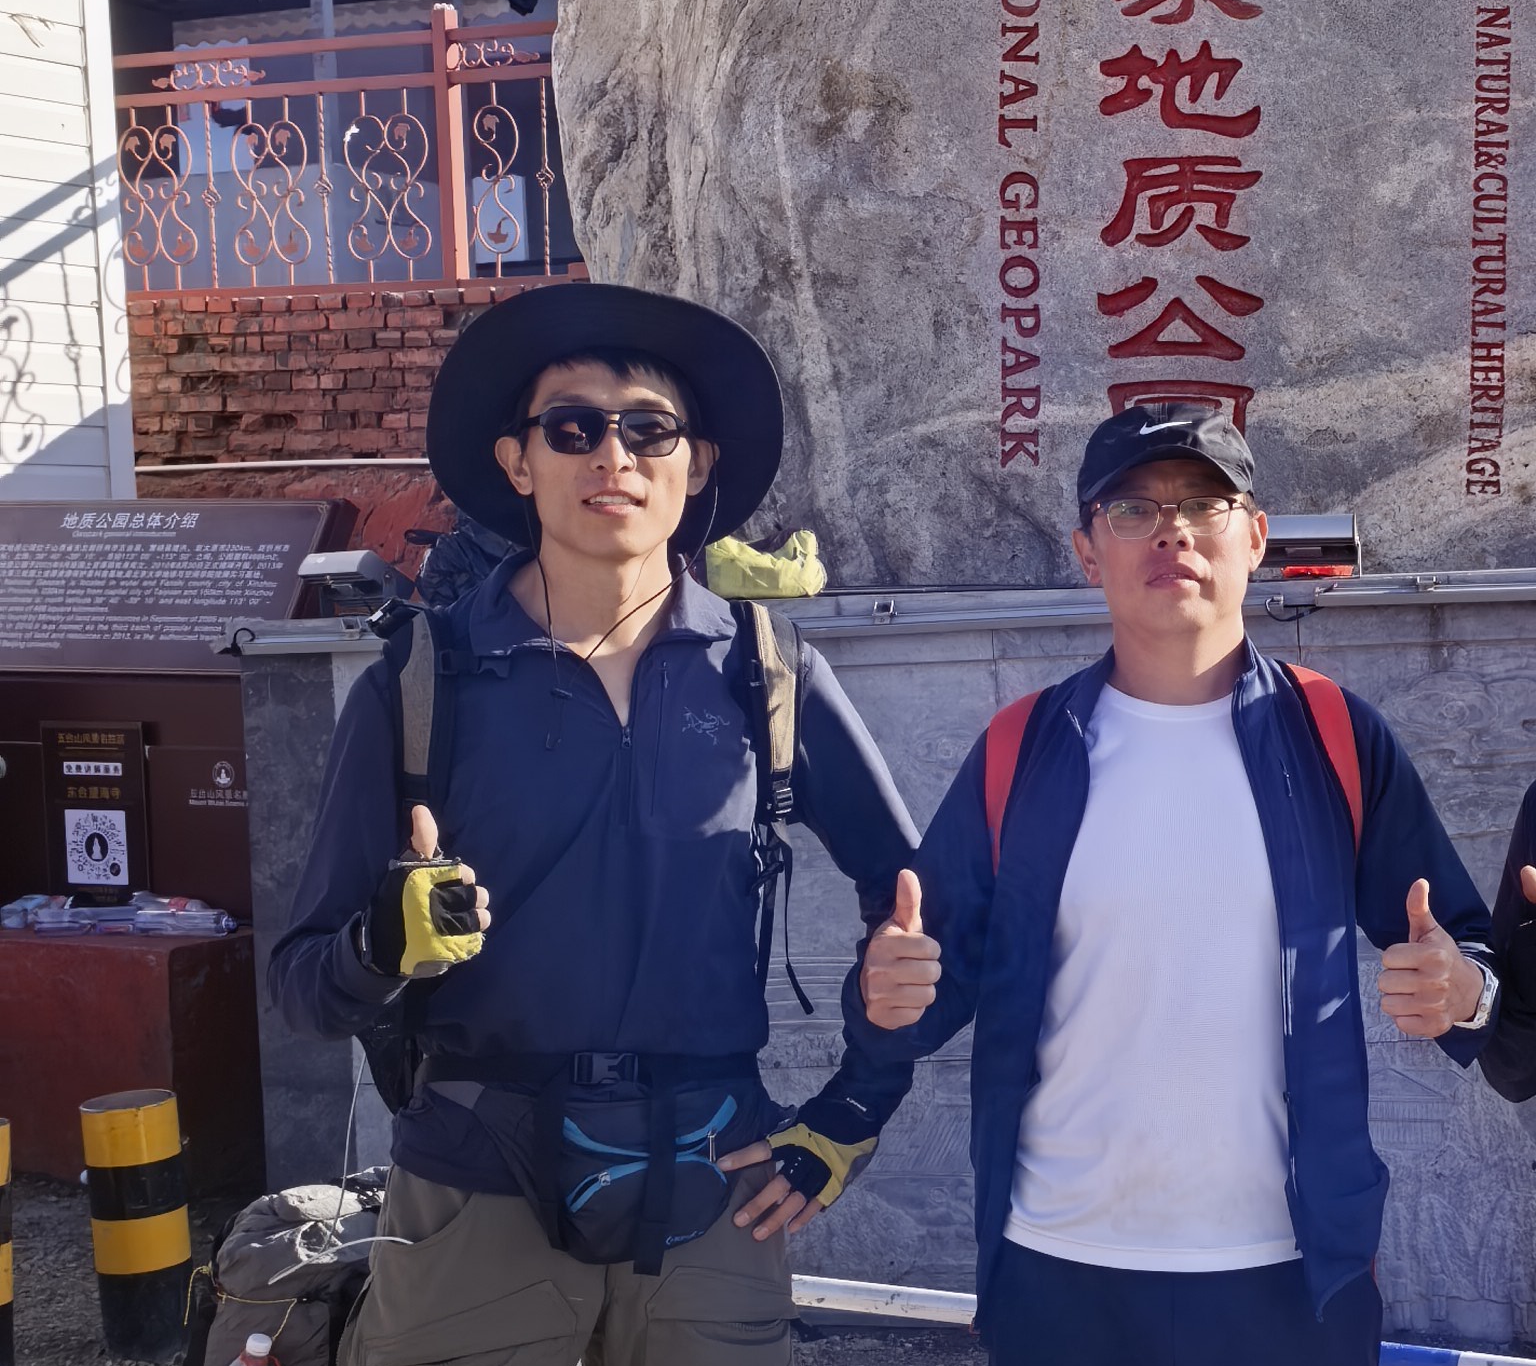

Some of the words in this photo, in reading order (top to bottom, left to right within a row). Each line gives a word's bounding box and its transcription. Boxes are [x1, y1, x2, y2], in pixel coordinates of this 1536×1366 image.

[998, 171, 1043, 468] GEOPARK
[1464, 340, 1507, 495] HERITAGE
[60, 511, 200, 530] 地质公园总体介绍
